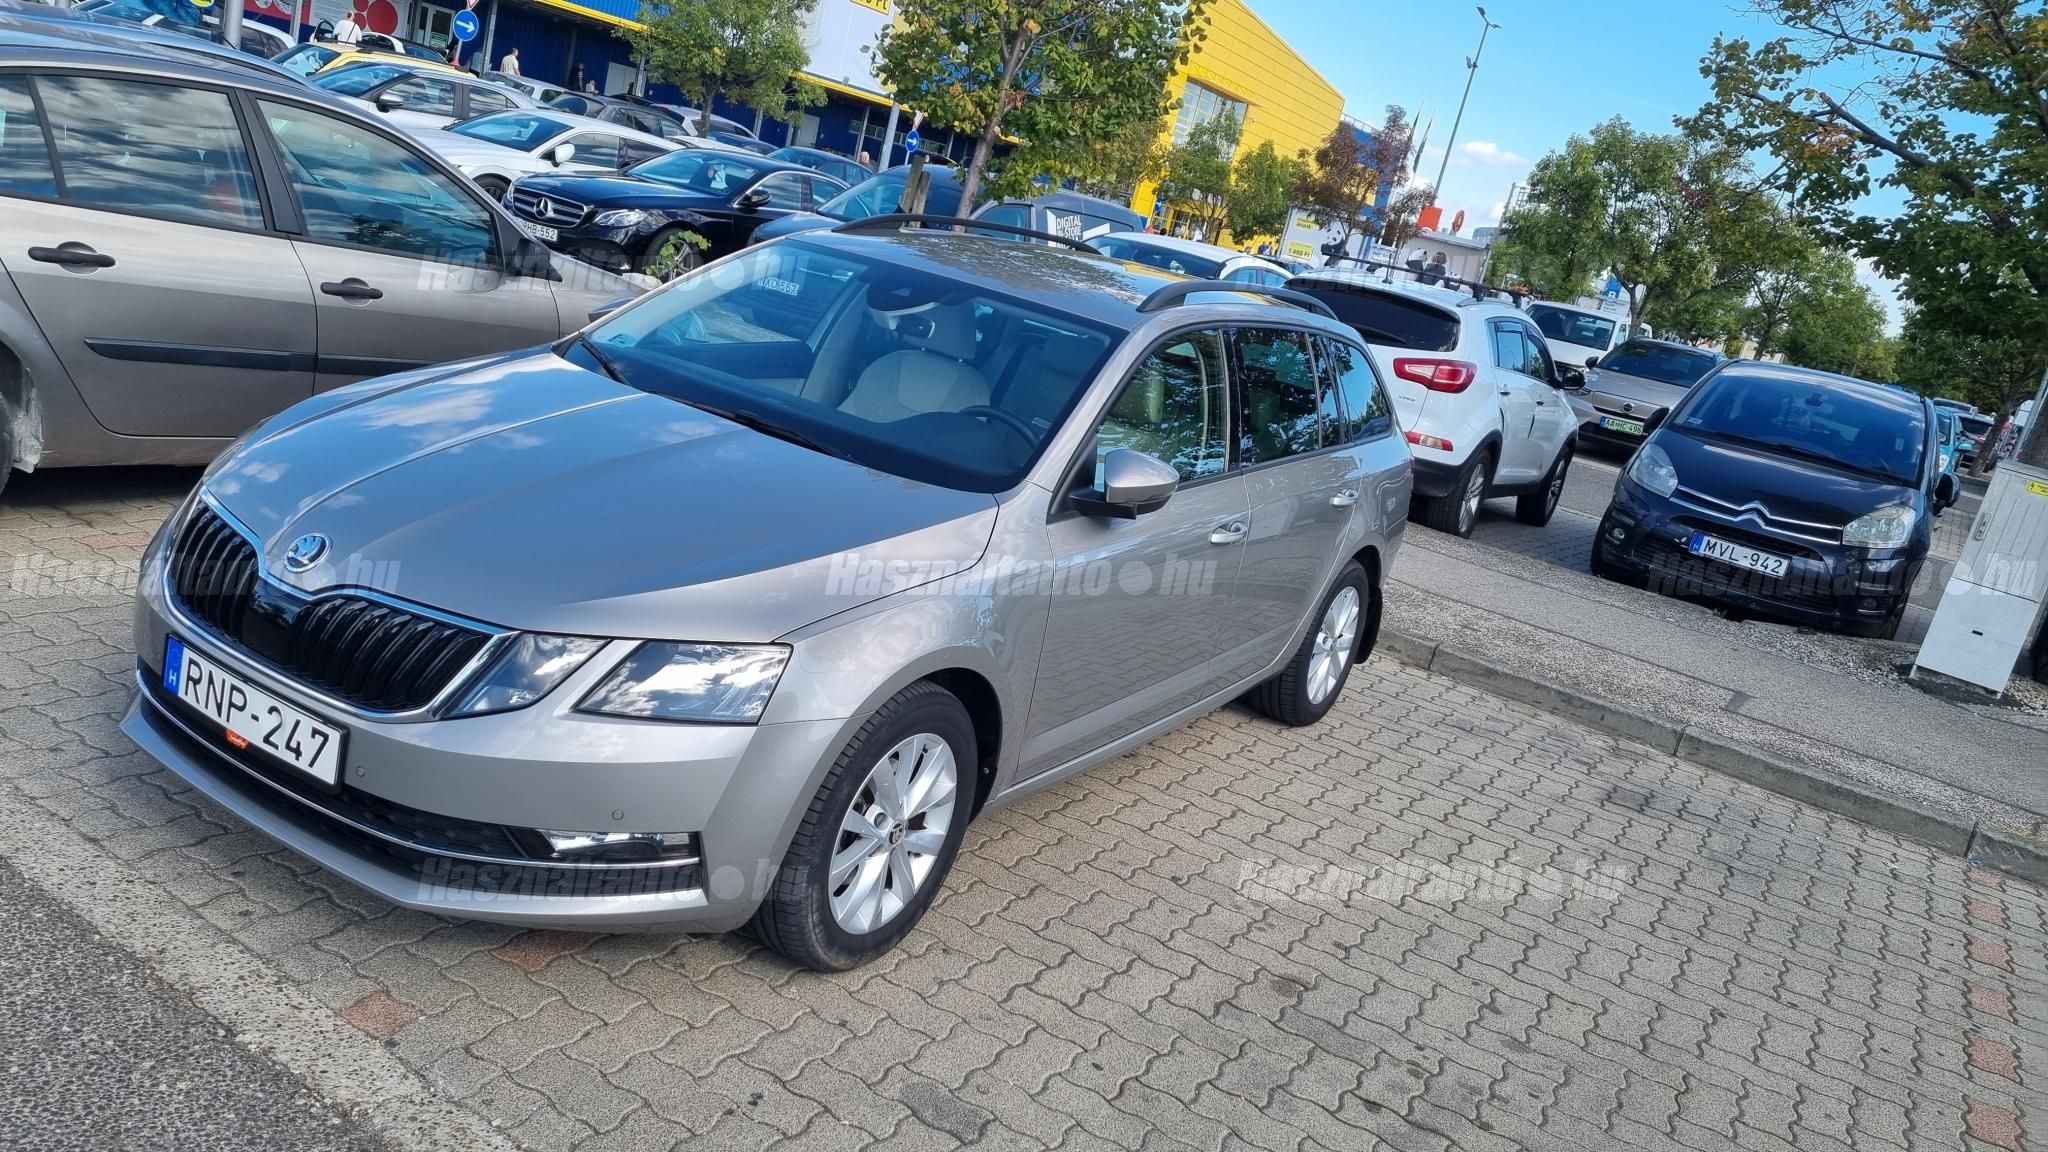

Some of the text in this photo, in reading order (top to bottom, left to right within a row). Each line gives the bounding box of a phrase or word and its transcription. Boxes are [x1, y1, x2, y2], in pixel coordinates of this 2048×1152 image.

[1056, 214, 1082, 229] DIGITAL
[1703, 538, 1783, 574] MVL-942
[184, 656, 330, 769] RNP-247
